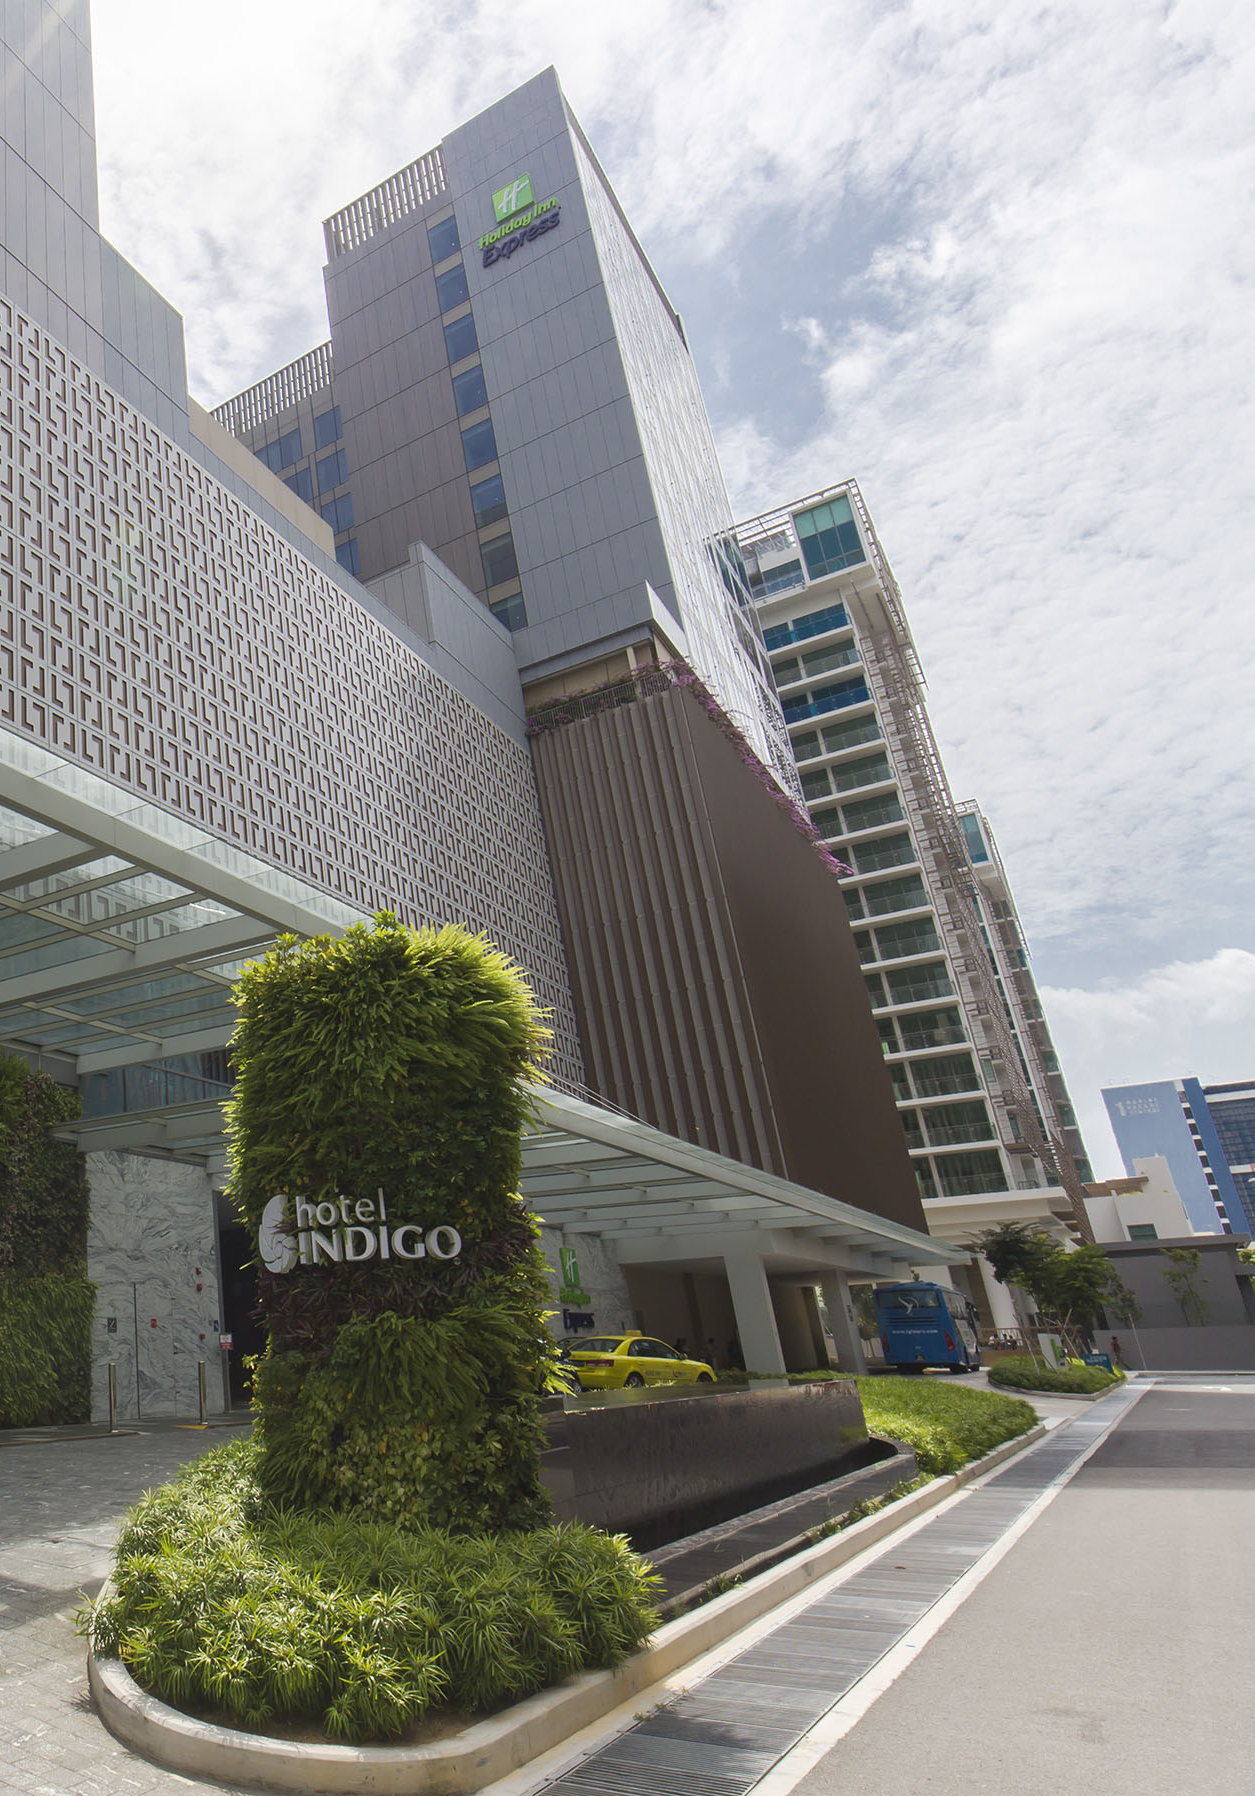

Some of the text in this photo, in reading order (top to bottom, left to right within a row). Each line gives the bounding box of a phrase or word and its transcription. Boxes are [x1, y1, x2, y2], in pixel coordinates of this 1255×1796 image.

[478, 197, 558, 250] Holiday Inn
[482, 211, 561, 269] Express
[296, 1187, 386, 1228] hotel
[297, 1225, 462, 1265] INDIGO
